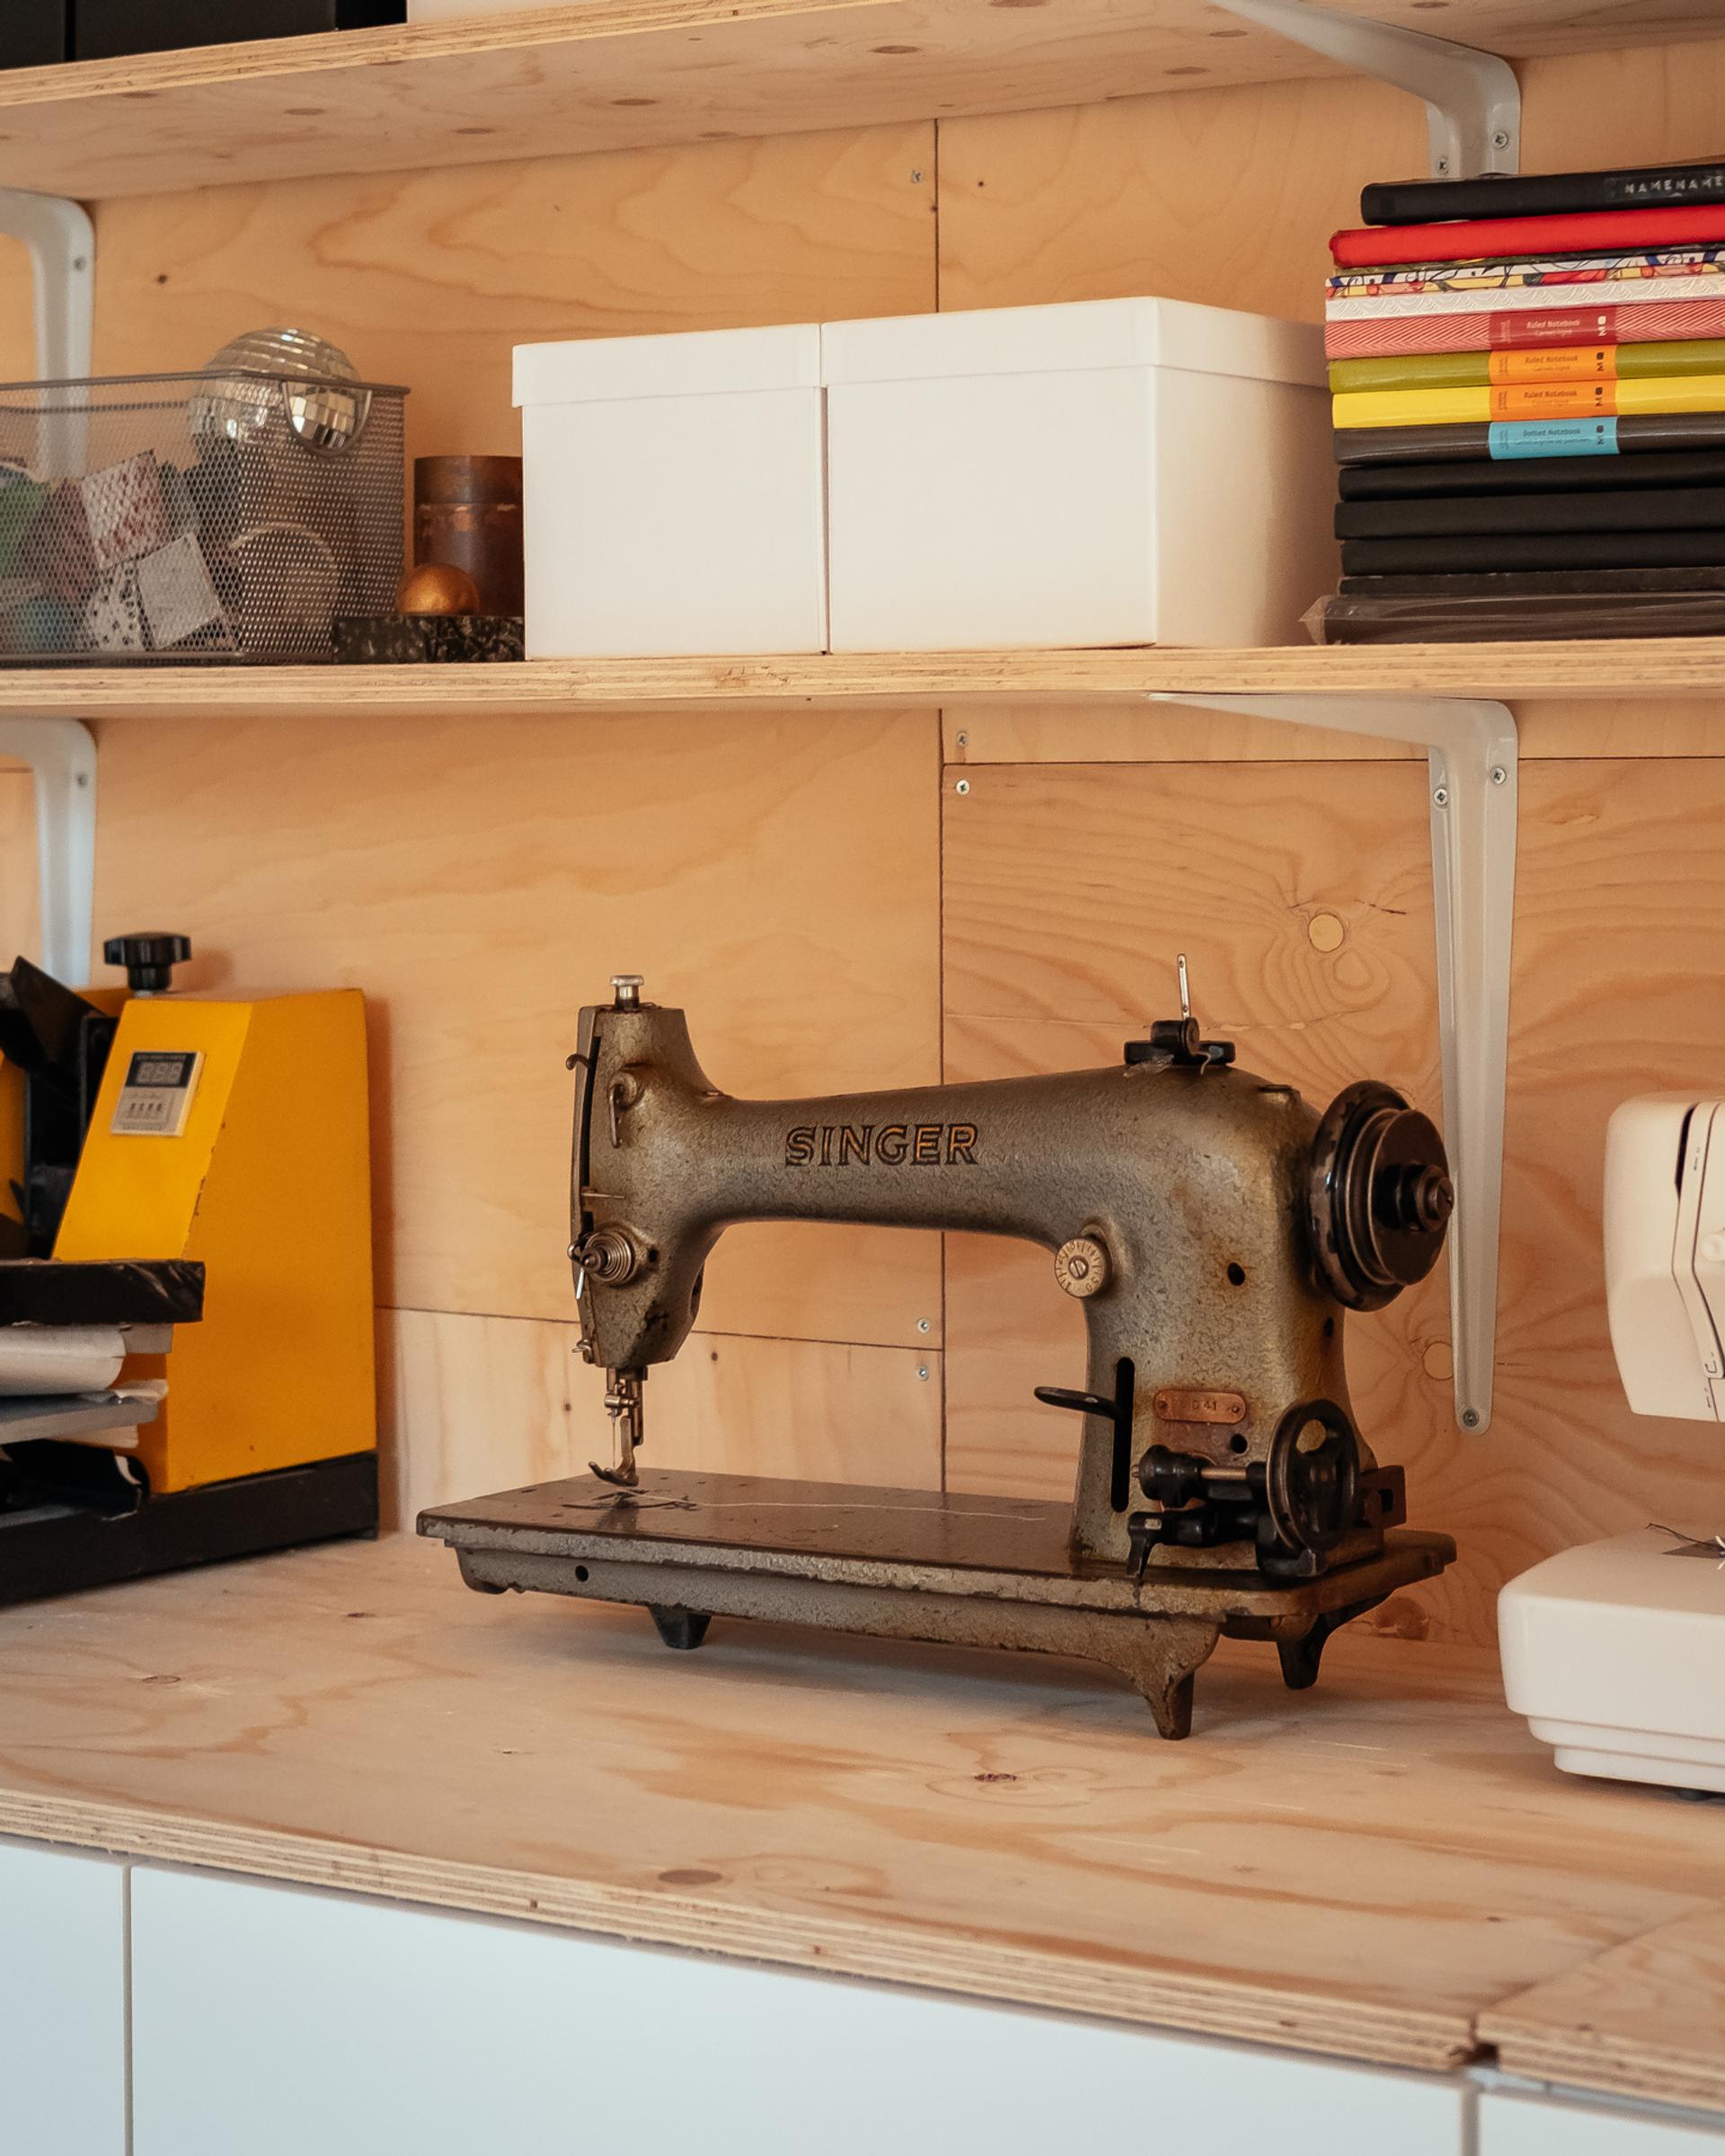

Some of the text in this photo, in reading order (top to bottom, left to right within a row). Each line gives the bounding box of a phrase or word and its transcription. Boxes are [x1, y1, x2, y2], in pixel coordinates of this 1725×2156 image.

[1547, 318, 1580, 328] Notebook
[1548, 428, 1580, 436] Notebook
[785, 1124, 978, 1166] SINGER
